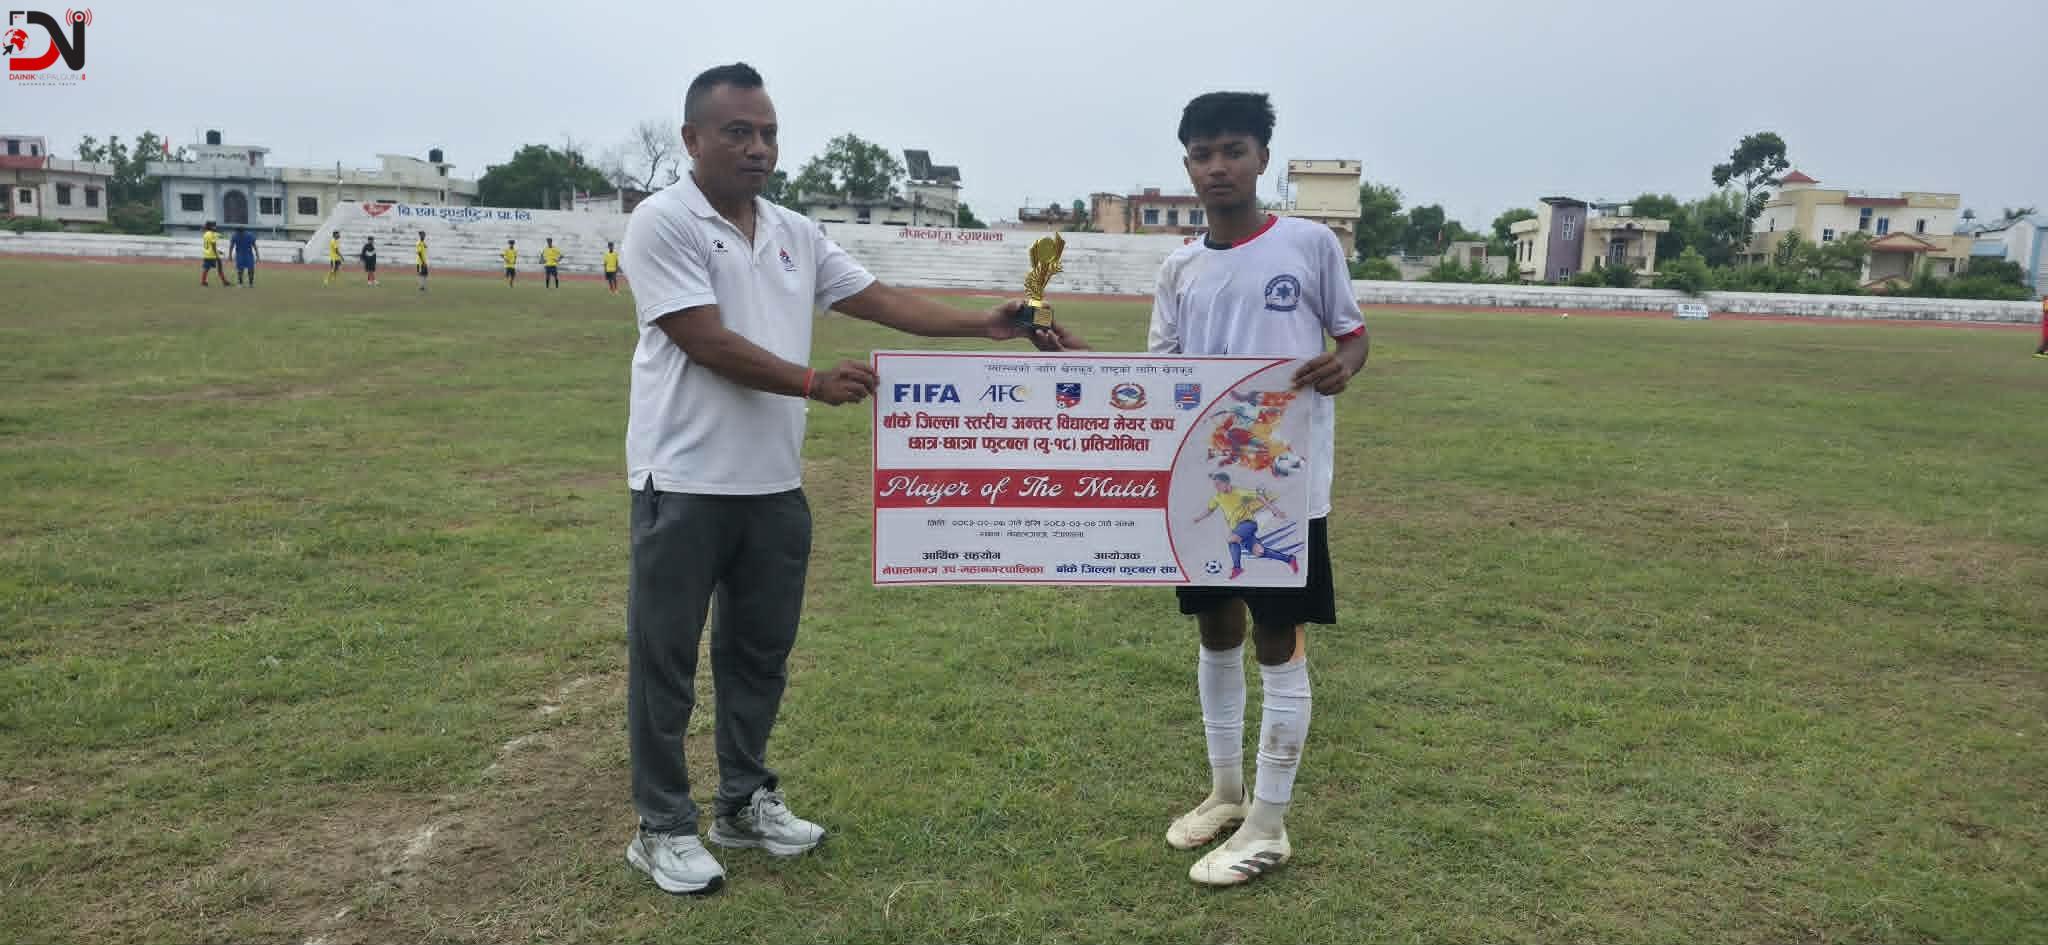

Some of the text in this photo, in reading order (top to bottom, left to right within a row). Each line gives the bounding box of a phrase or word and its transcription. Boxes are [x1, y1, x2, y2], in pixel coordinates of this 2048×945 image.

[894, 383, 961, 403] FIFA
[978, 385, 1025, 402] AFC
[916, 411, 960, 430] जिल्ला
[964, 412, 1008, 430] स्तरीय
[1012, 416, 1052, 430] अन्तर
[1057, 413, 1109, 431] विद्यालय
[1114, 414, 1147, 431] मेयर
[1151, 418, 1176, 431] कप
[908, 436, 977, 450] छात्र-छात्रा
[982, 437, 1029, 453] फुटबल
[1081, 434, 1150, 452] प्रतियोगिता
[879, 475, 1160, 505] Player of The Match
[922, 549, 1001, 561] आर्थिक सहयोग
[1094, 551, 1142, 561] आयोजक
[1081, 563, 1116, 574] जिल्ला
[1119, 565, 1156, 577] फुटबल
